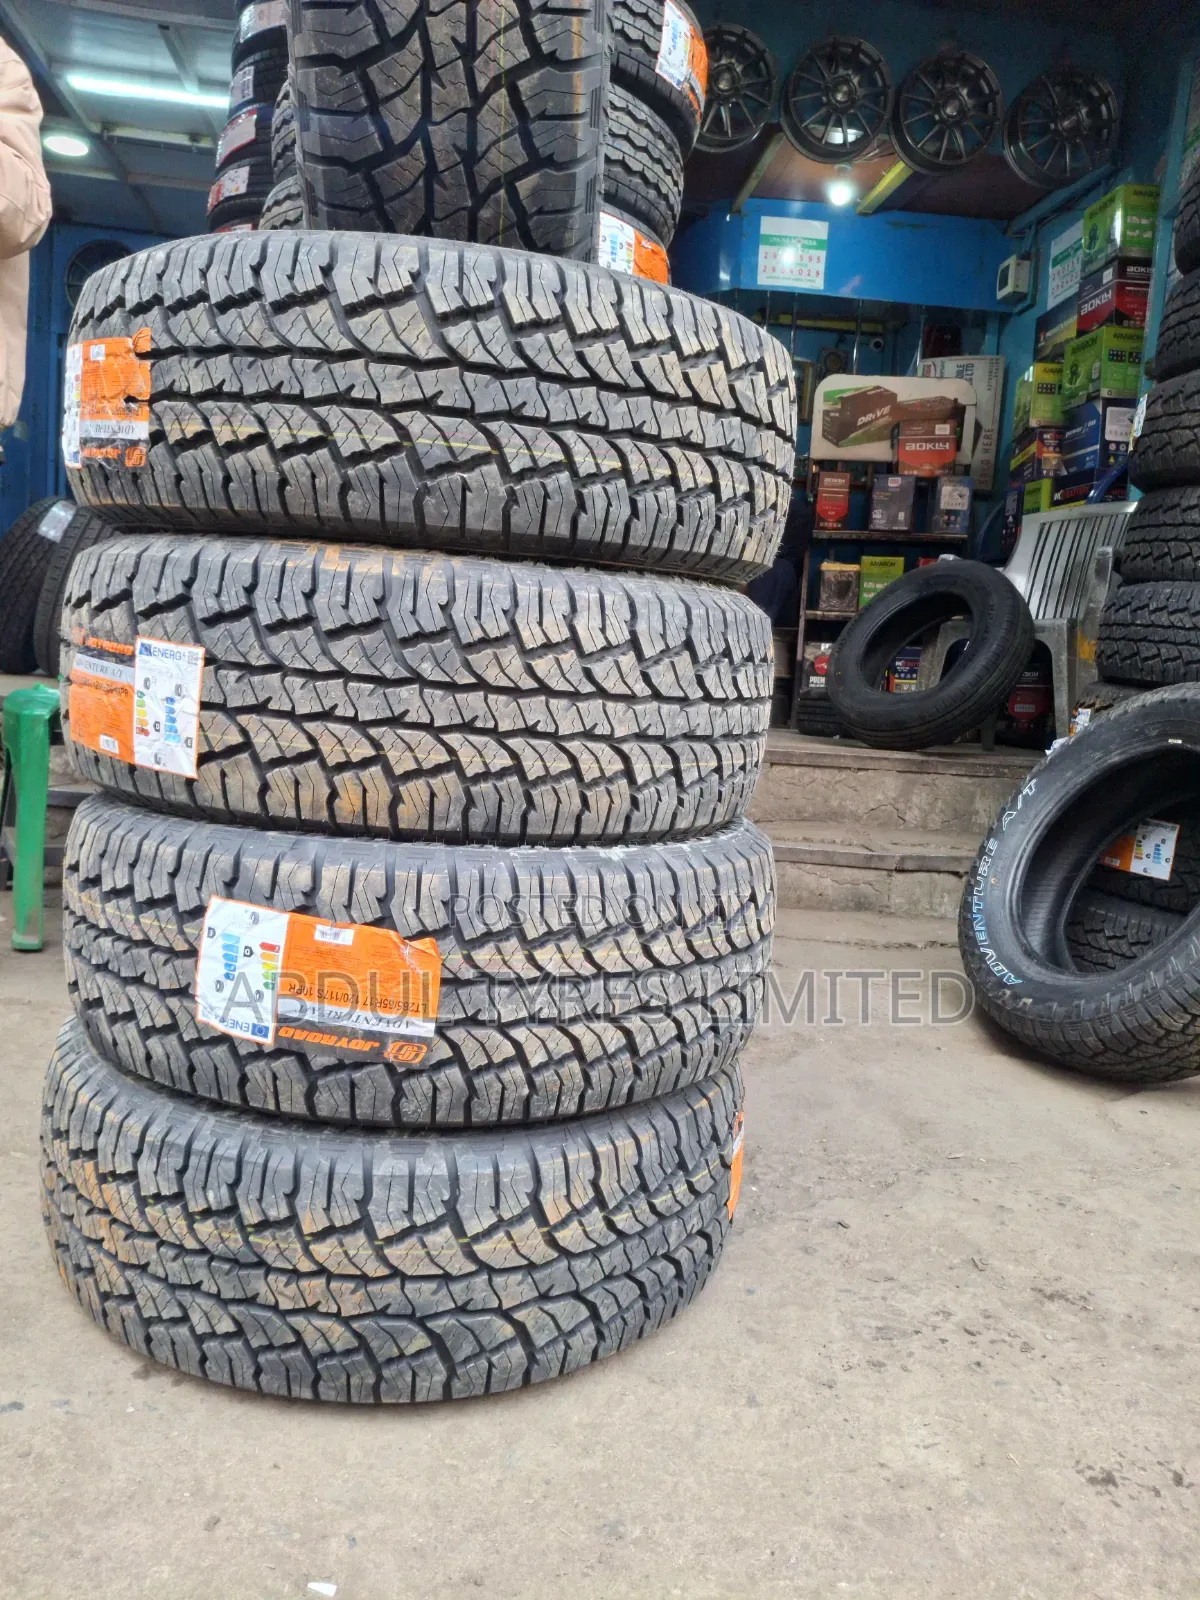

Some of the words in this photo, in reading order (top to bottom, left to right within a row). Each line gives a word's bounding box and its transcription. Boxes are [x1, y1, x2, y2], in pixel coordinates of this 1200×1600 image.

[971, 837, 1025, 985] ADVENTURE
[319, 1005, 414, 1031] ADVENTURE
[277, 1025, 381, 1052] JOYROAD
